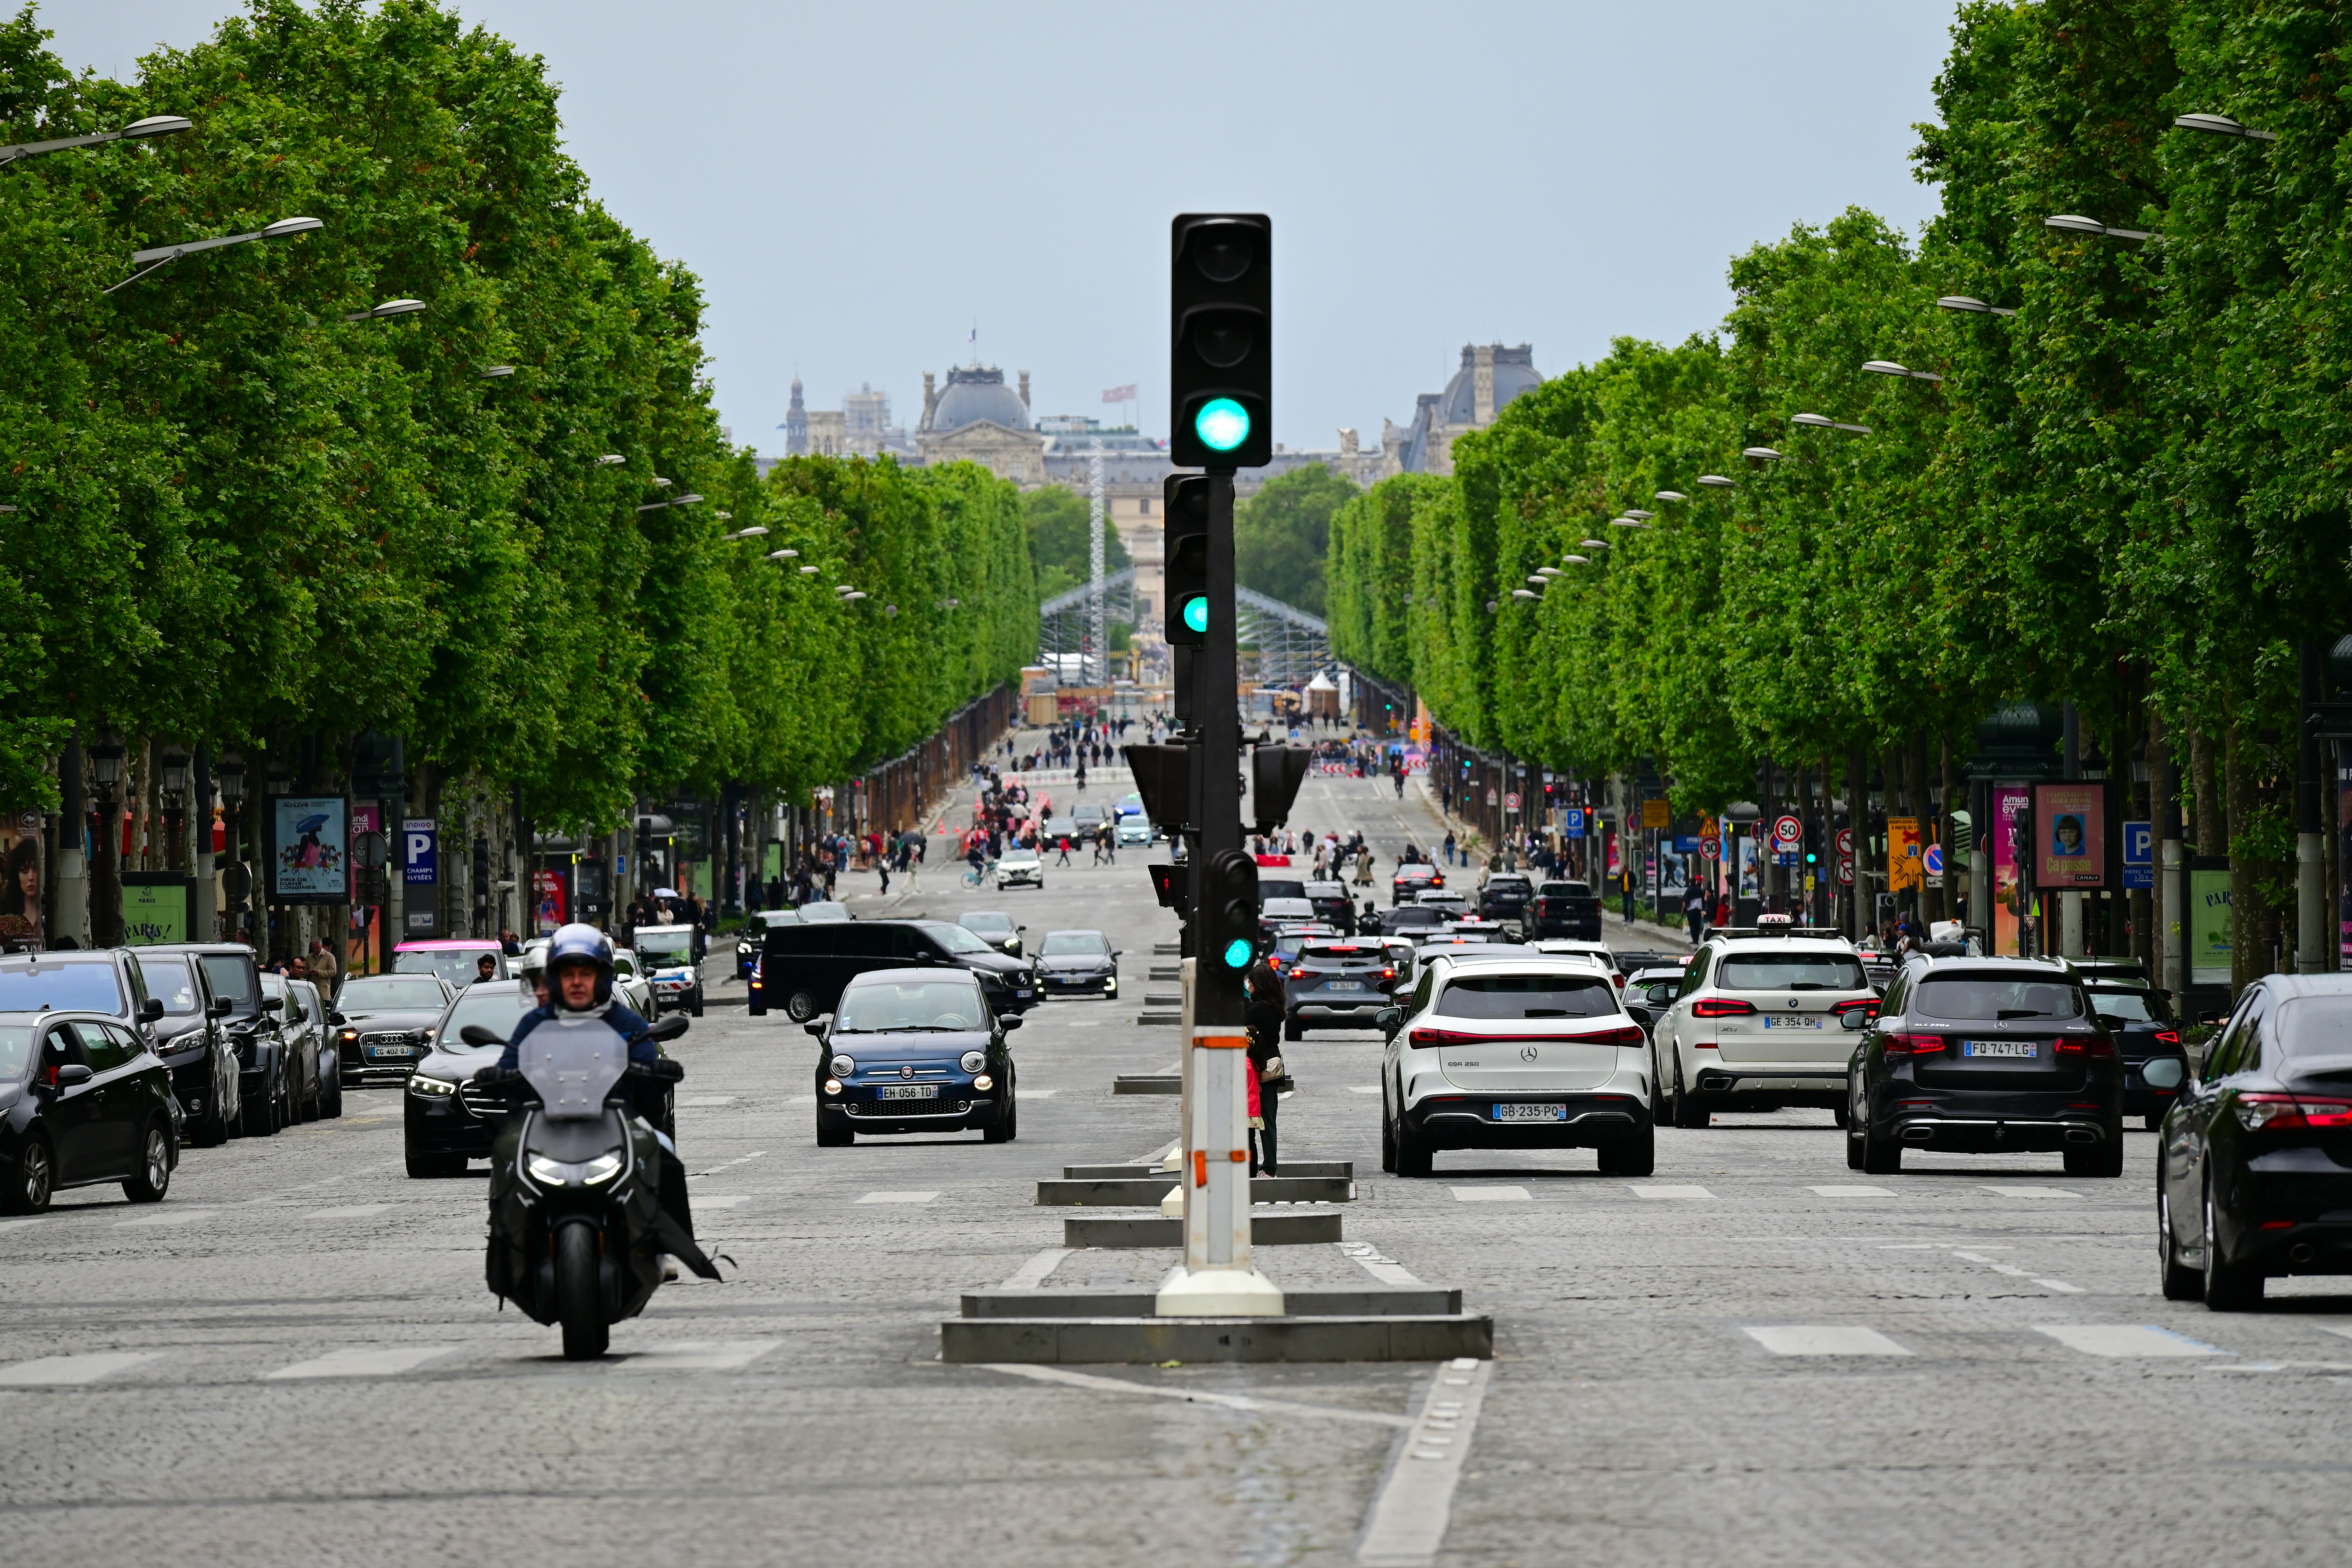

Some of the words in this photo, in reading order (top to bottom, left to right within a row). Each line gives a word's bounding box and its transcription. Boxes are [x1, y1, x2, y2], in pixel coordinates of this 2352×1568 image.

[1571, 812, 1579, 825] P
[1781, 825, 1796, 836] 50
[408, 834, 431, 864] P
[1704, 842, 1717, 853] 30
[2136, 831, 2151, 856] P
[2047, 857, 2059, 874] Ça
[2061, 860, 2091, 875] passe
[1771, 1018, 1816, 1026] GE-354-QH
[1973, 1043, 2028, 1055] FQ-747-LG
[884, 1087, 931, 1098] EH-056-TD
[1501, 1106, 1558, 1116] GB-235-PQ
